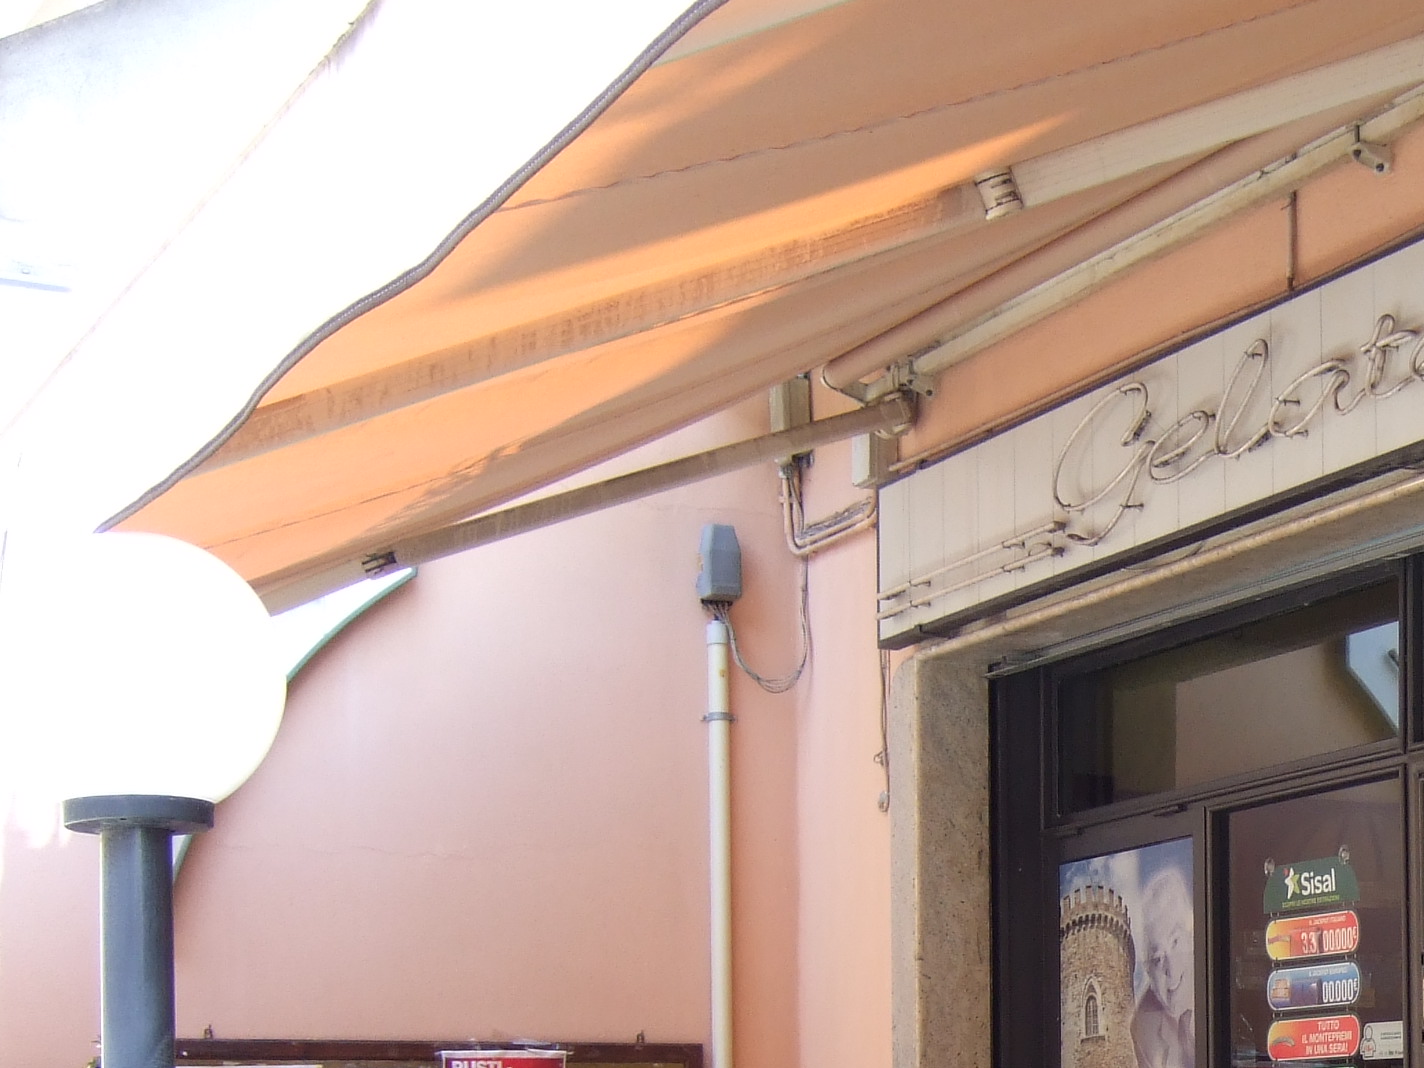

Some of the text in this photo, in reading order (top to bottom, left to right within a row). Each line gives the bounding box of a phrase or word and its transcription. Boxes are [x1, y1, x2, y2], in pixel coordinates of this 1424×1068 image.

[1301, 867, 1337, 896] Sisal
[1317, 1021, 1340, 1031] TUTTO
[1308, 1030, 1353, 1043] MONTEPREMI
[1314, 1044, 1328, 1055] UNA
